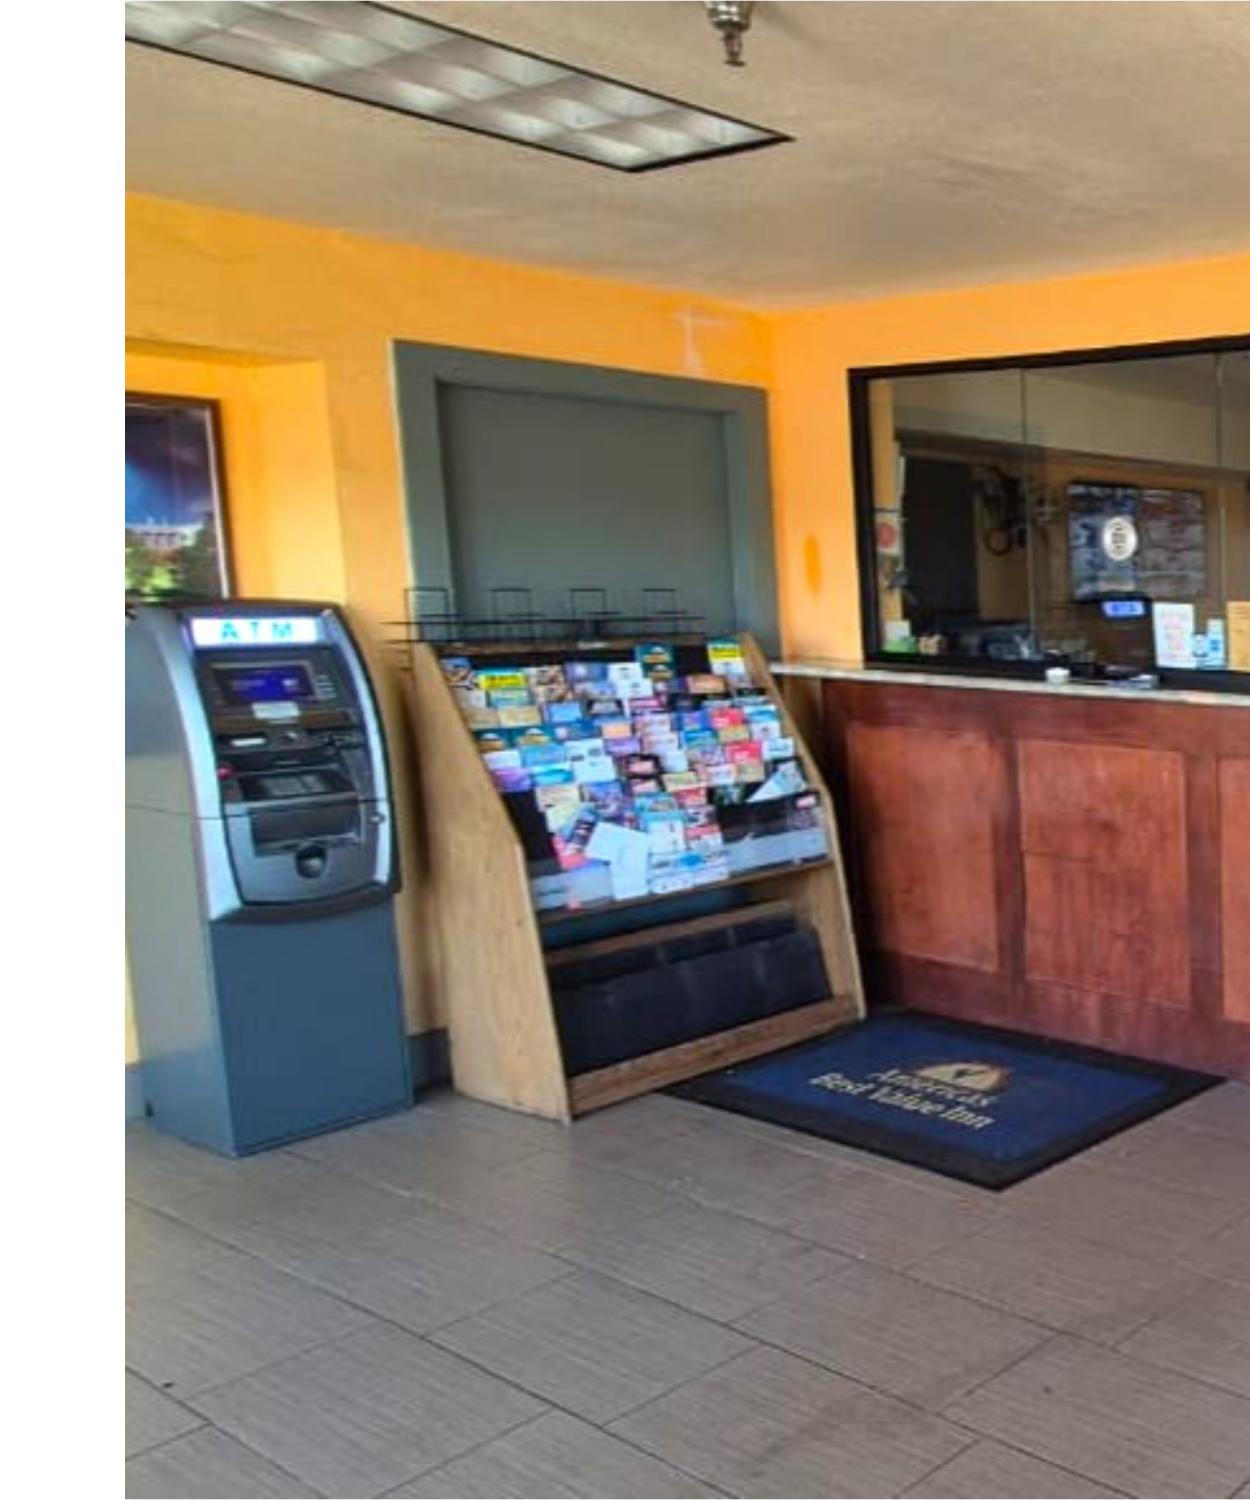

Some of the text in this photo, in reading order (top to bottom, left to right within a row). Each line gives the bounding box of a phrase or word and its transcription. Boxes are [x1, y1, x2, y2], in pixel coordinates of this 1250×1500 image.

[221, 621, 293, 639] ATM
[809, 1073, 995, 1131] Best Value Inn
